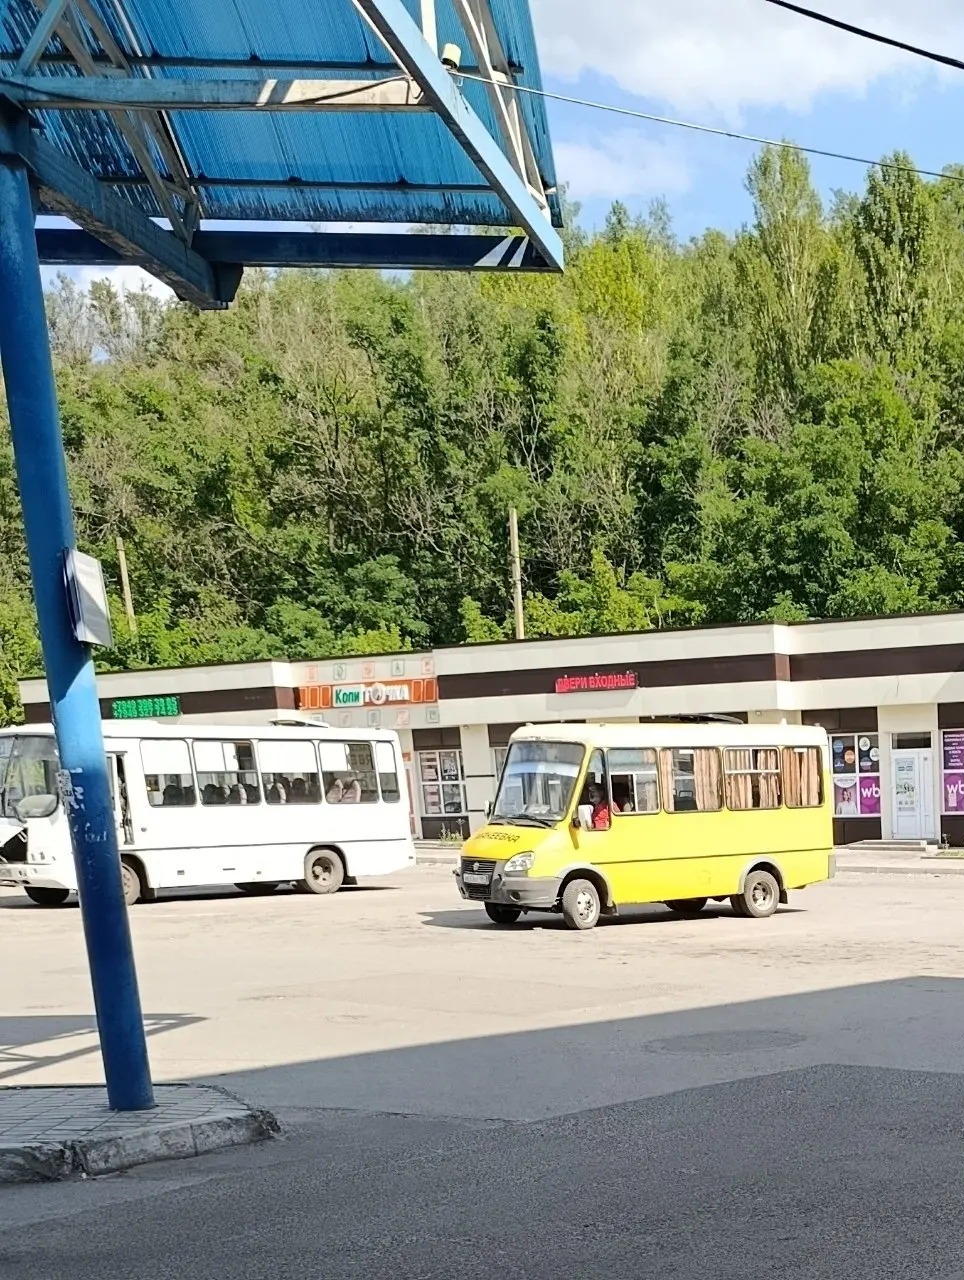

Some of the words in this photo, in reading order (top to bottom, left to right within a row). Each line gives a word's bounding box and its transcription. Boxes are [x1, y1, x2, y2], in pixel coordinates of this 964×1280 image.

[556, 677, 587, 691] ДВЕРИ
[589, 673, 636, 688] ВХОДНЫЕ
[335, 689, 360, 703] Копи
[861, 784, 880, 798] wb
